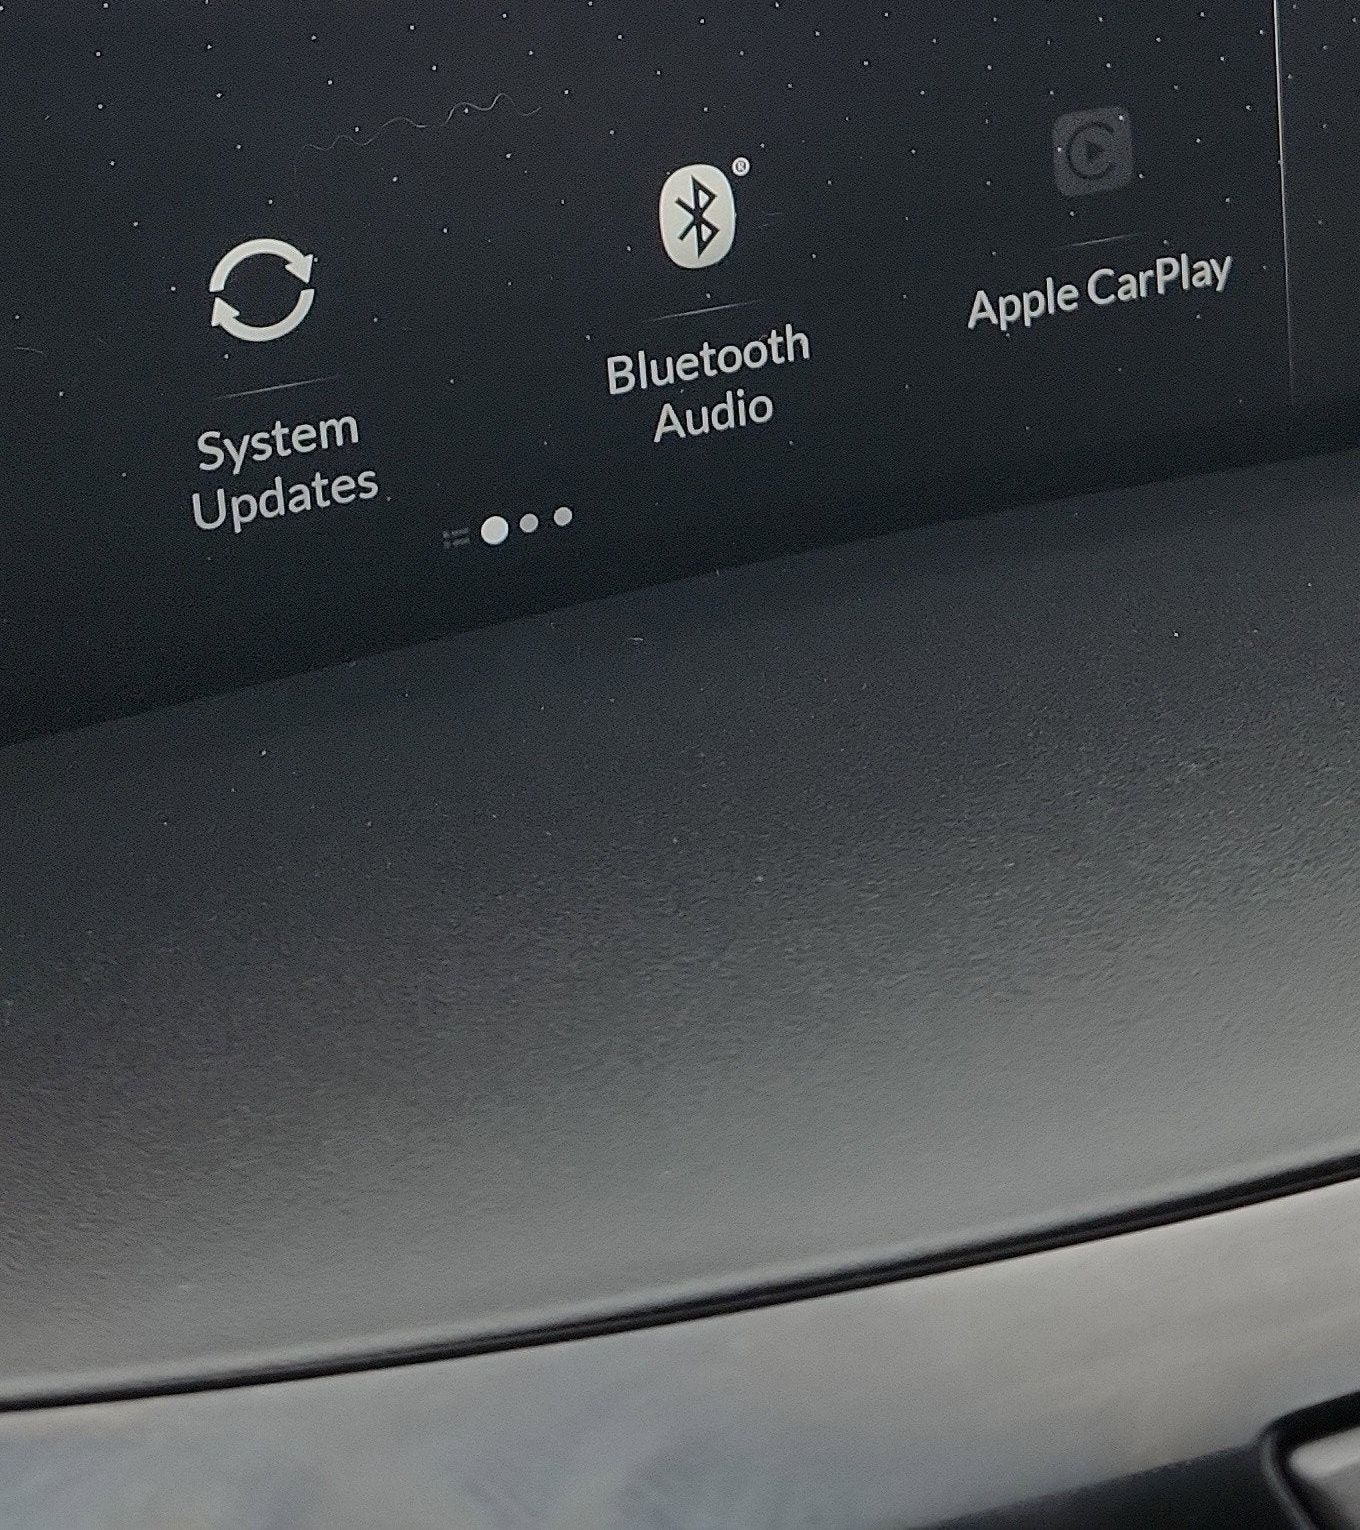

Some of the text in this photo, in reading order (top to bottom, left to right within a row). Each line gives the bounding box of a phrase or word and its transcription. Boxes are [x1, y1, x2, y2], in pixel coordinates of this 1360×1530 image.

[967, 252, 1233, 332] Apple CarPlay
[606, 323, 810, 395] Bluetooth
[197, 415, 359, 476] System
[653, 388, 774, 443] Audio
[191, 470, 379, 534] Updates
